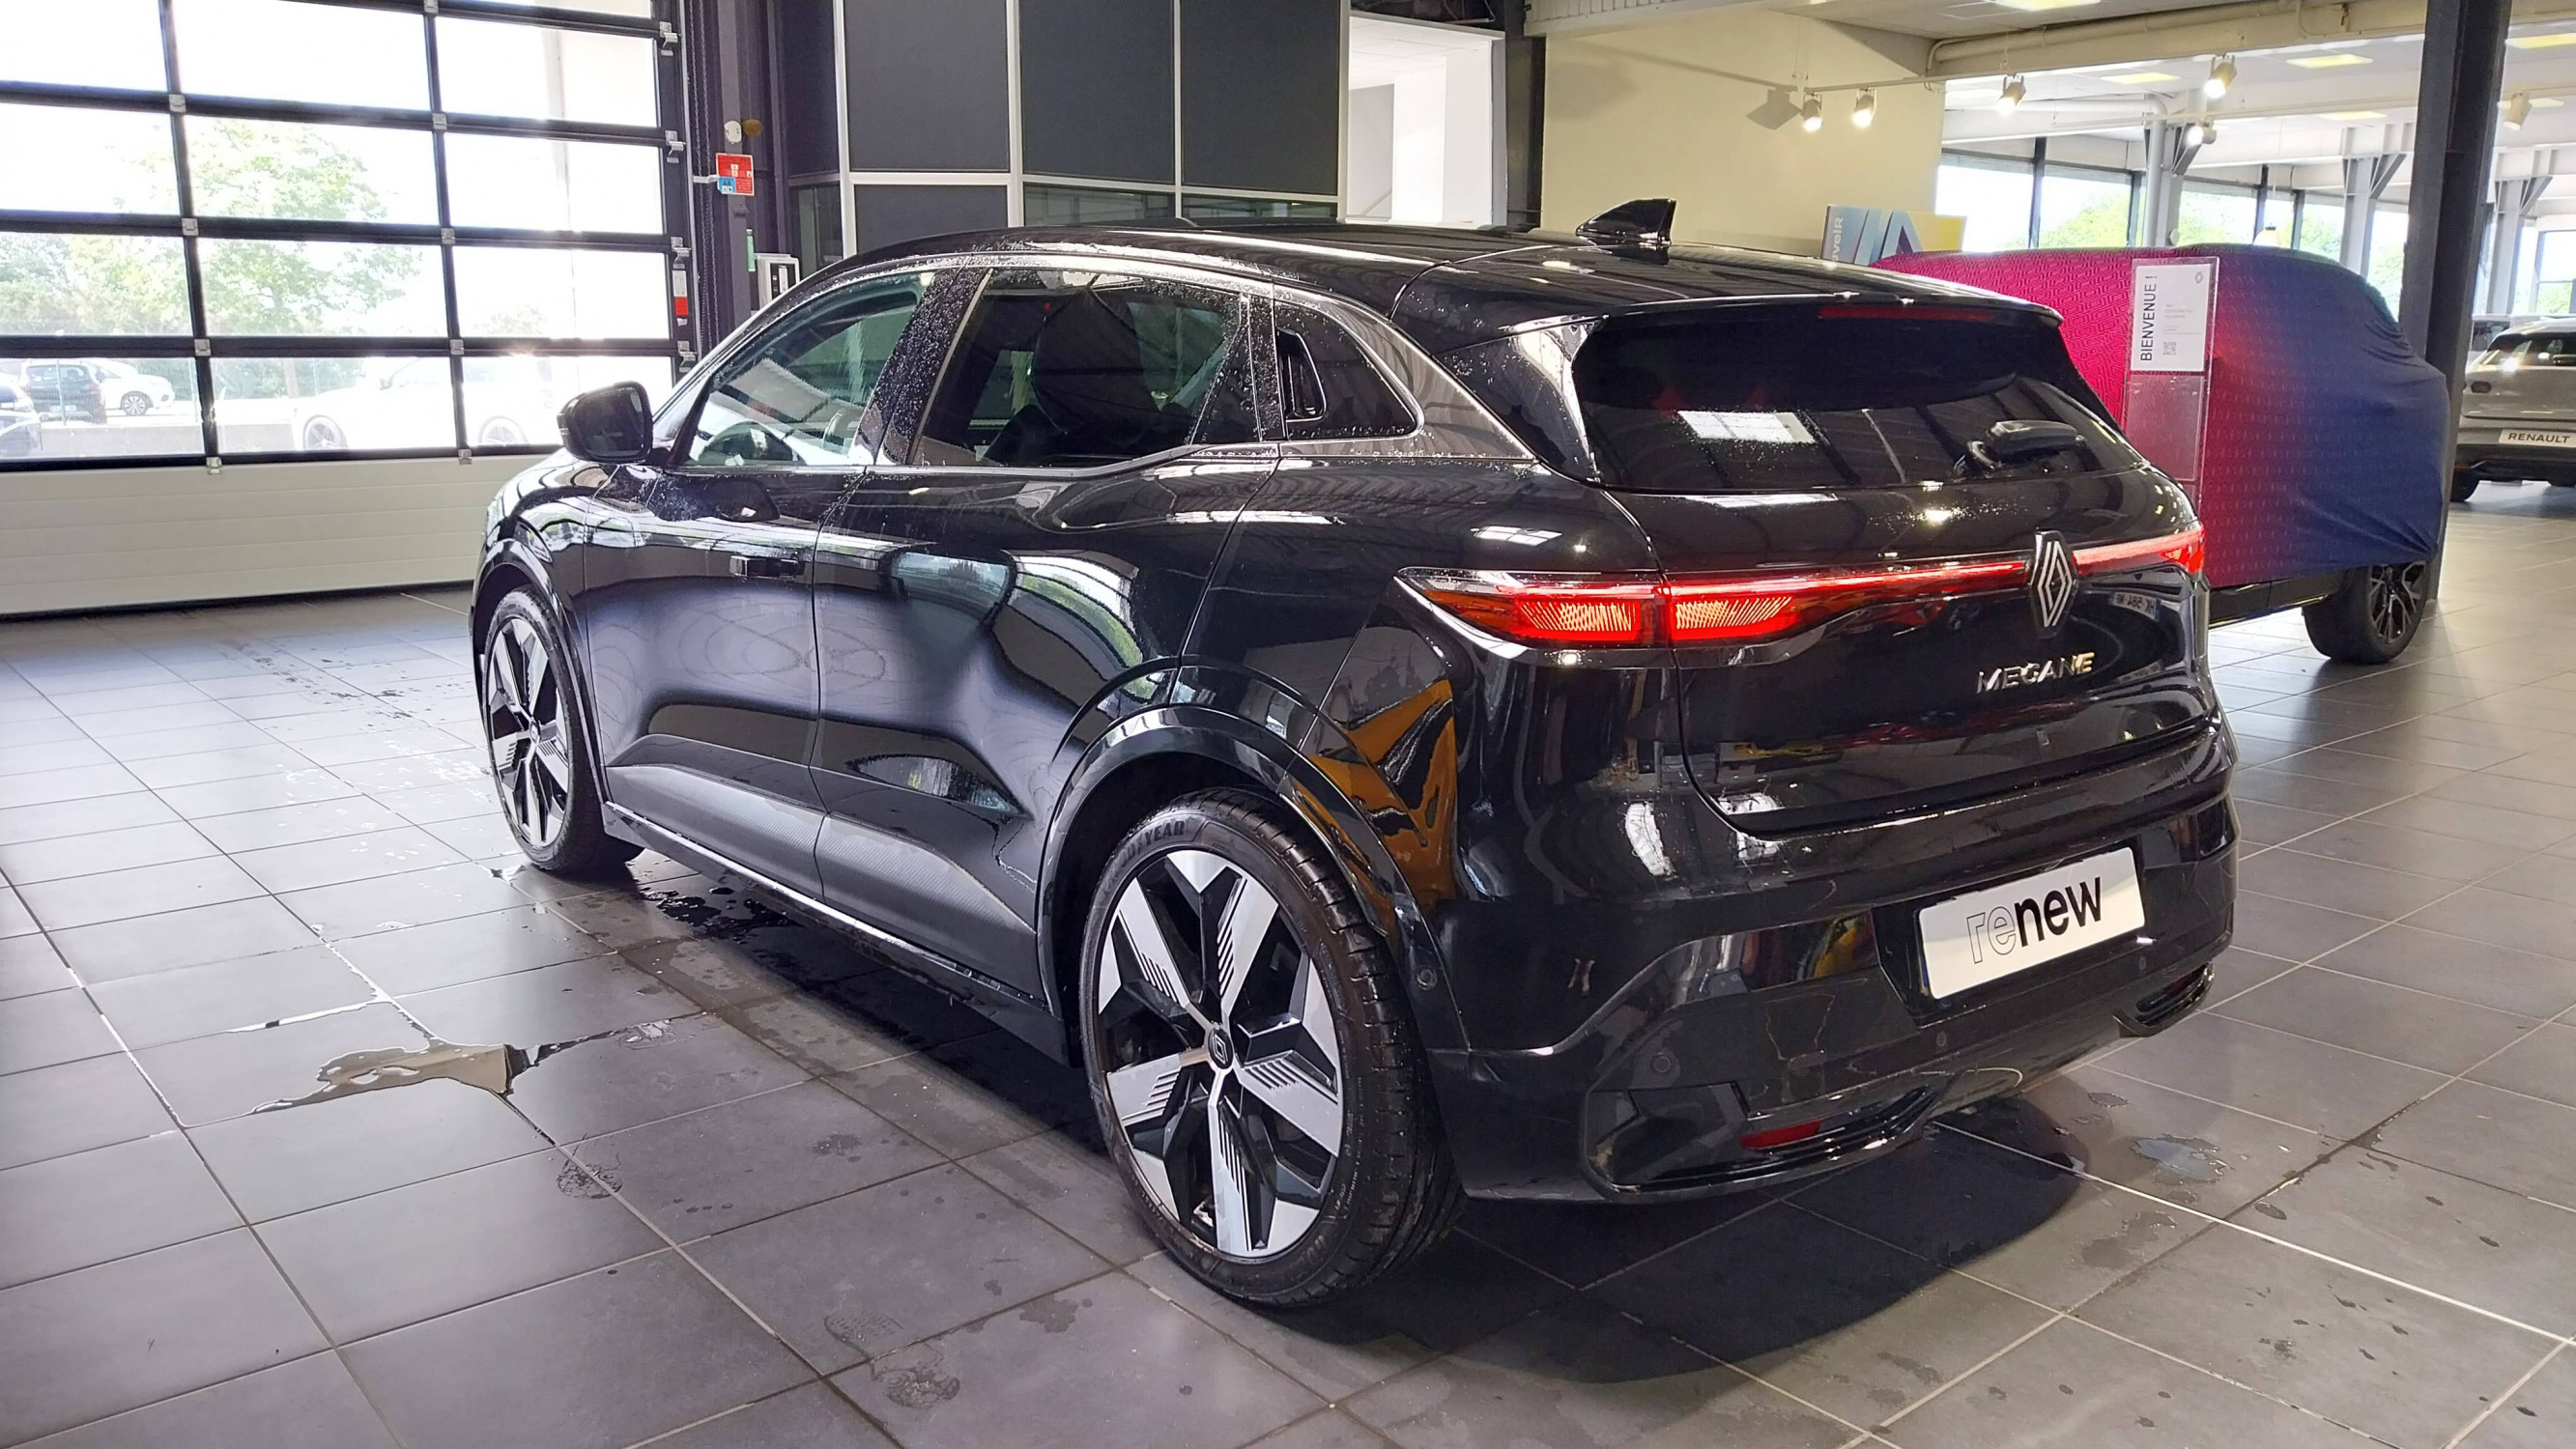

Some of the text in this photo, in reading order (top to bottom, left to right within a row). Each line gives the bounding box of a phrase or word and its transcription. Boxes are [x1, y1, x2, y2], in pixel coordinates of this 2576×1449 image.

[2140, 283, 2157, 361] BIENVENUE
[2507, 432, 2570, 443] RENAULT
[1966, 876, 2102, 964] renew
